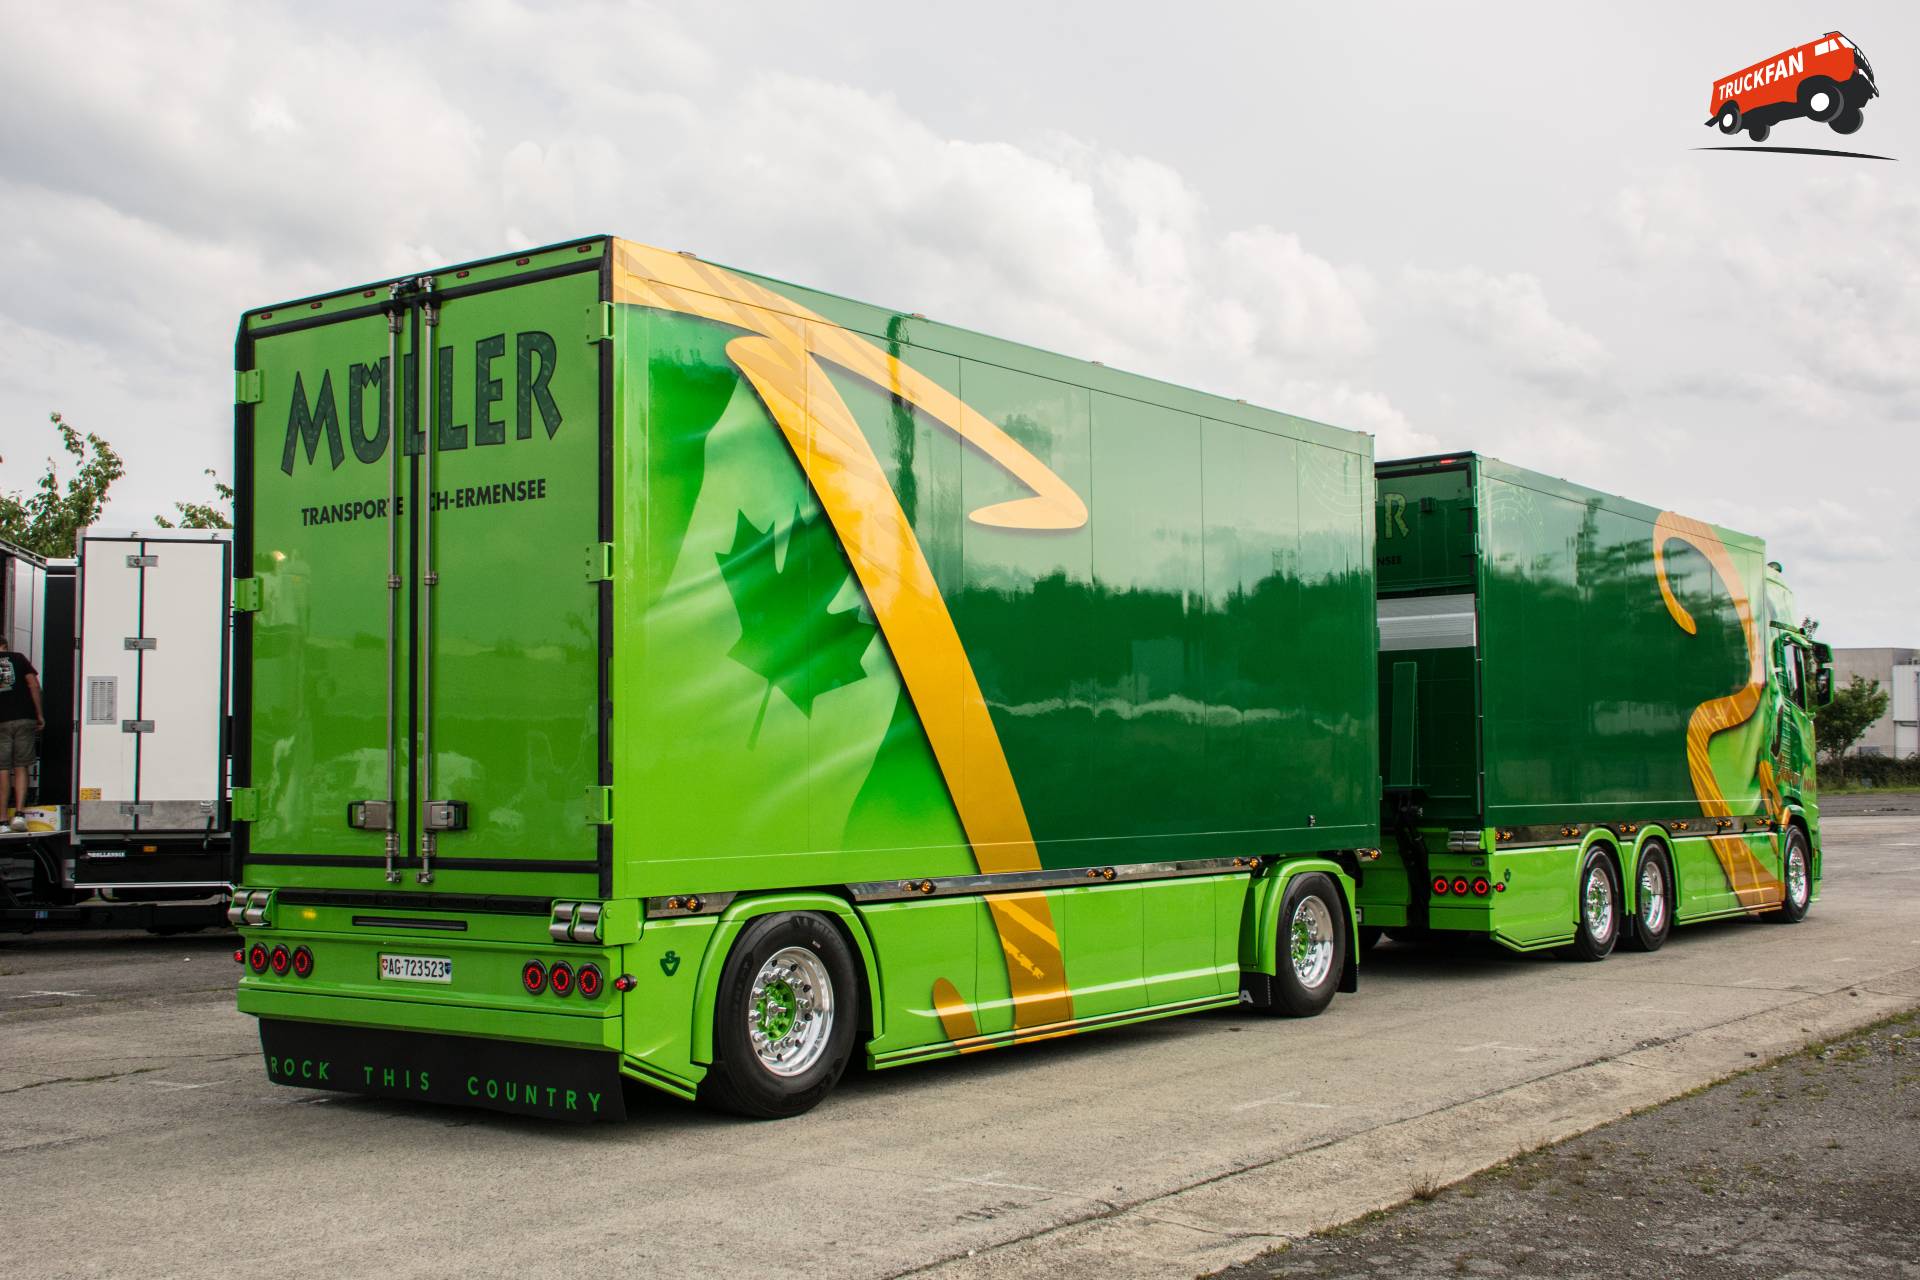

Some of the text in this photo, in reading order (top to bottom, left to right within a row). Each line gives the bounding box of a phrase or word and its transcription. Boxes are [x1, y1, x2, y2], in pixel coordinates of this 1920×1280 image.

[281, 330, 563, 477] MÜLLER
[301, 496, 404, 527] TRANSPORE
[271, 1056, 601, 1112] ROCK THIS COUNTRY
